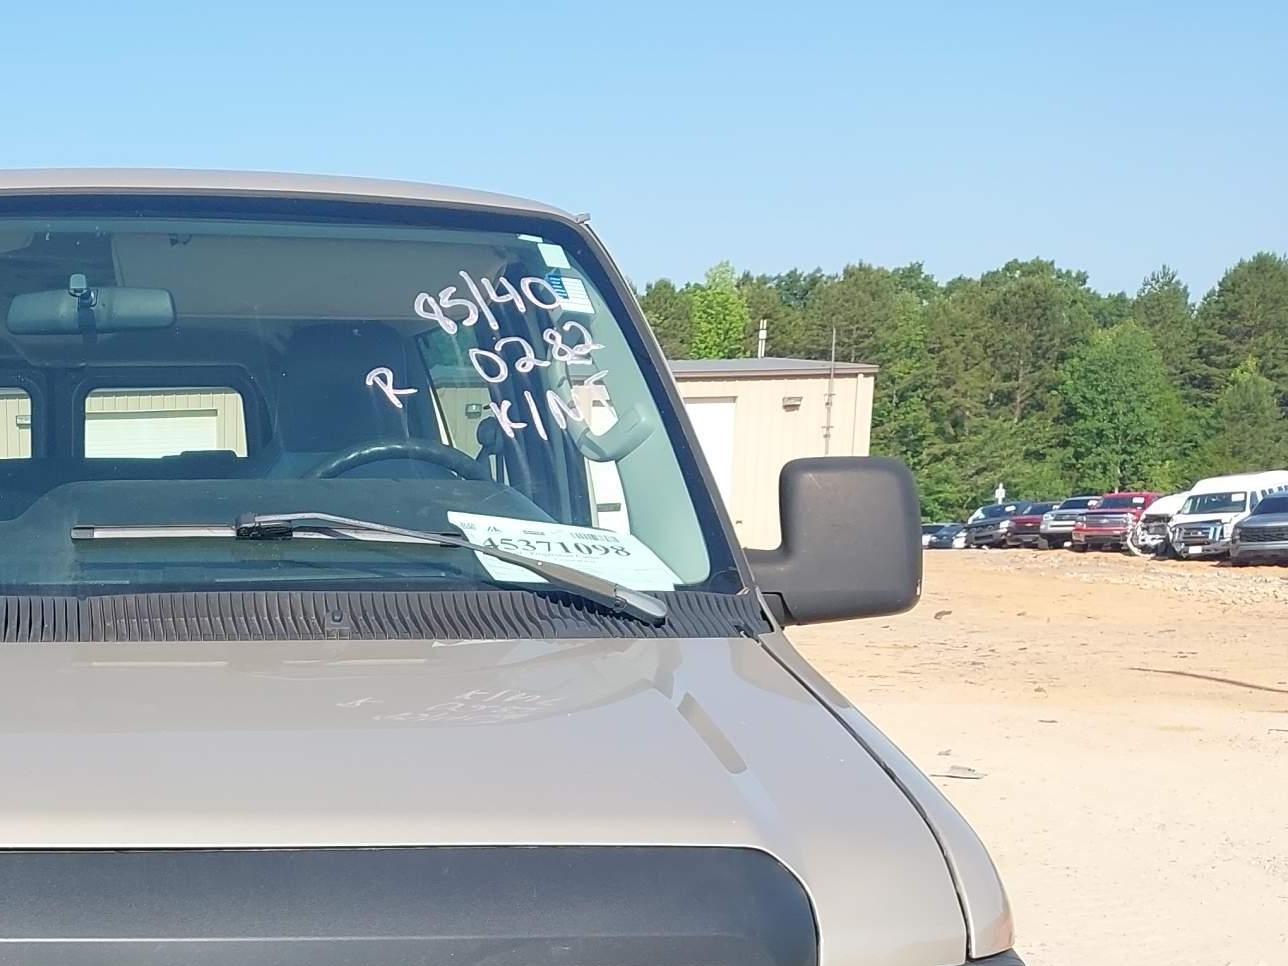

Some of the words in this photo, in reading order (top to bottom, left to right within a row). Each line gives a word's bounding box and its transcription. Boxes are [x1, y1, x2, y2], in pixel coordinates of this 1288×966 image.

[468, 320, 607, 384] 0282
[365, 366, 419, 409] R
[483, 536, 632, 558] 45371098
